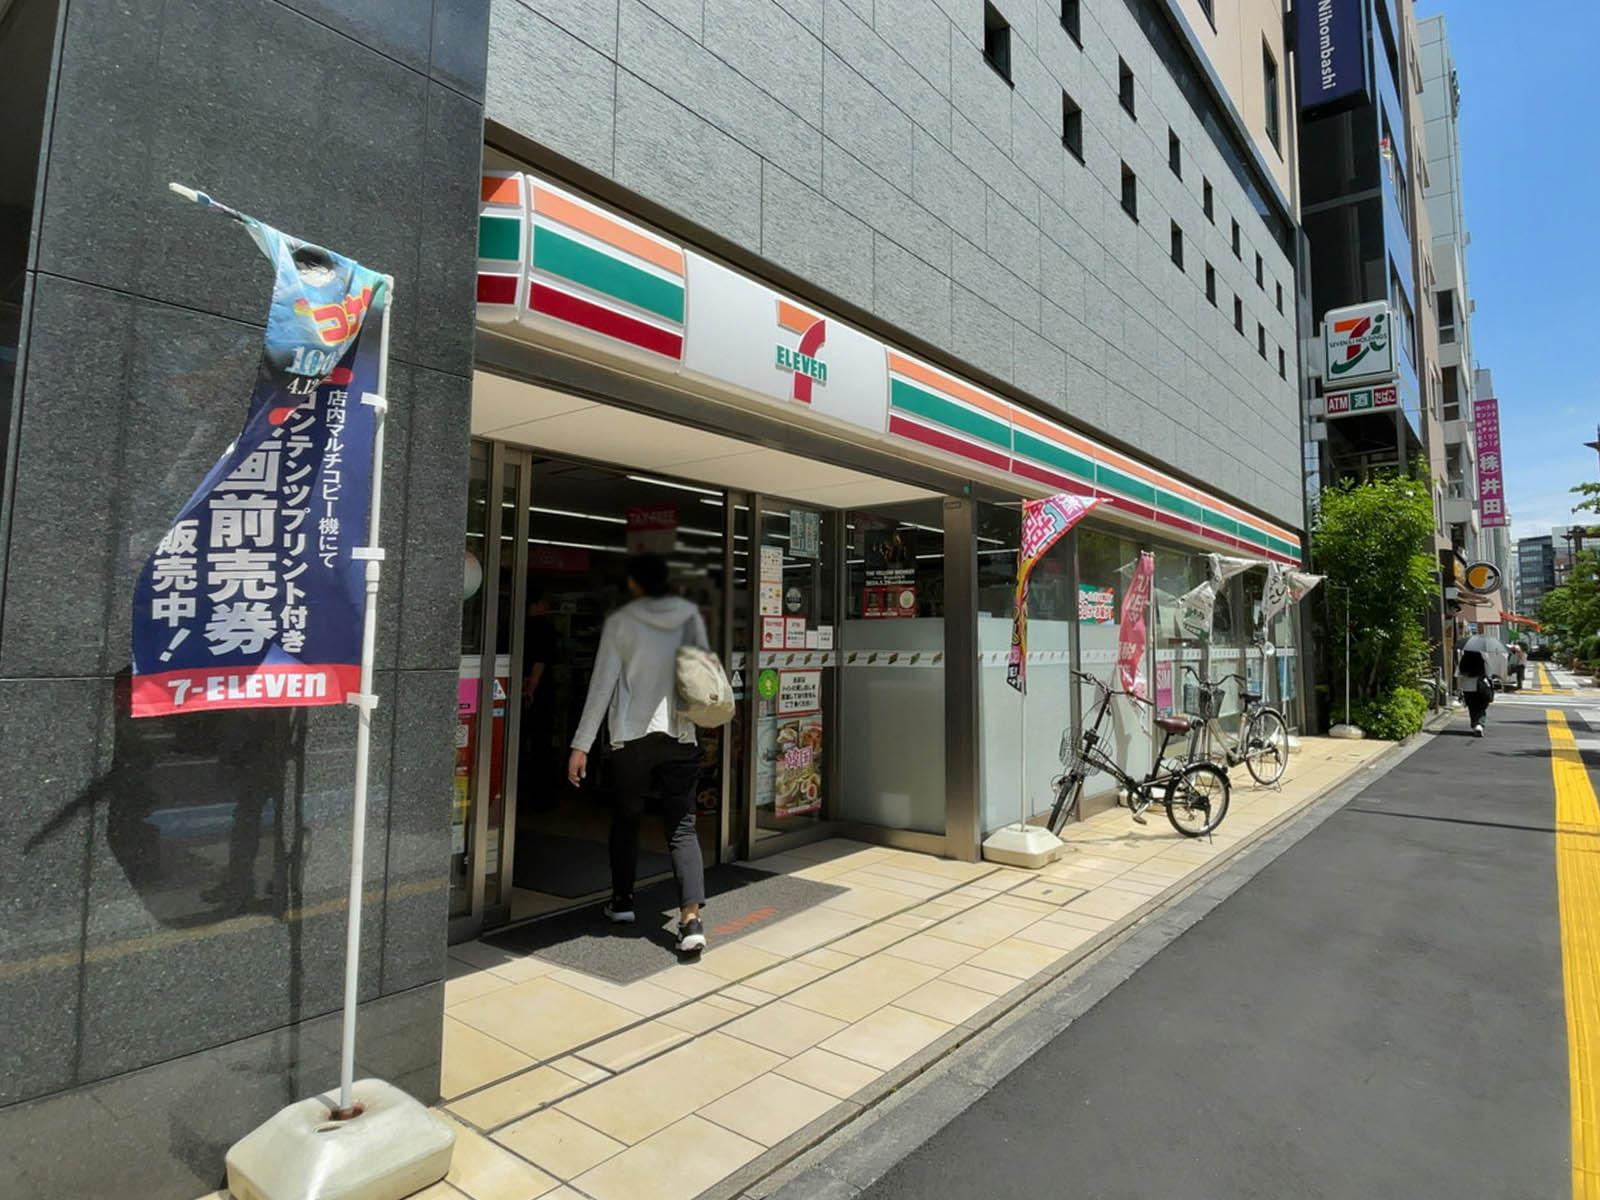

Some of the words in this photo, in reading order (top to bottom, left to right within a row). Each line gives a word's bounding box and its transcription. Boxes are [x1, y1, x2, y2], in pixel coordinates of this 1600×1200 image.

[318, 390, 349, 569] 店内マルチコピー機にて
[1328, 395, 1349, 412] ATM
[203, 428, 284, 656] 画前売券
